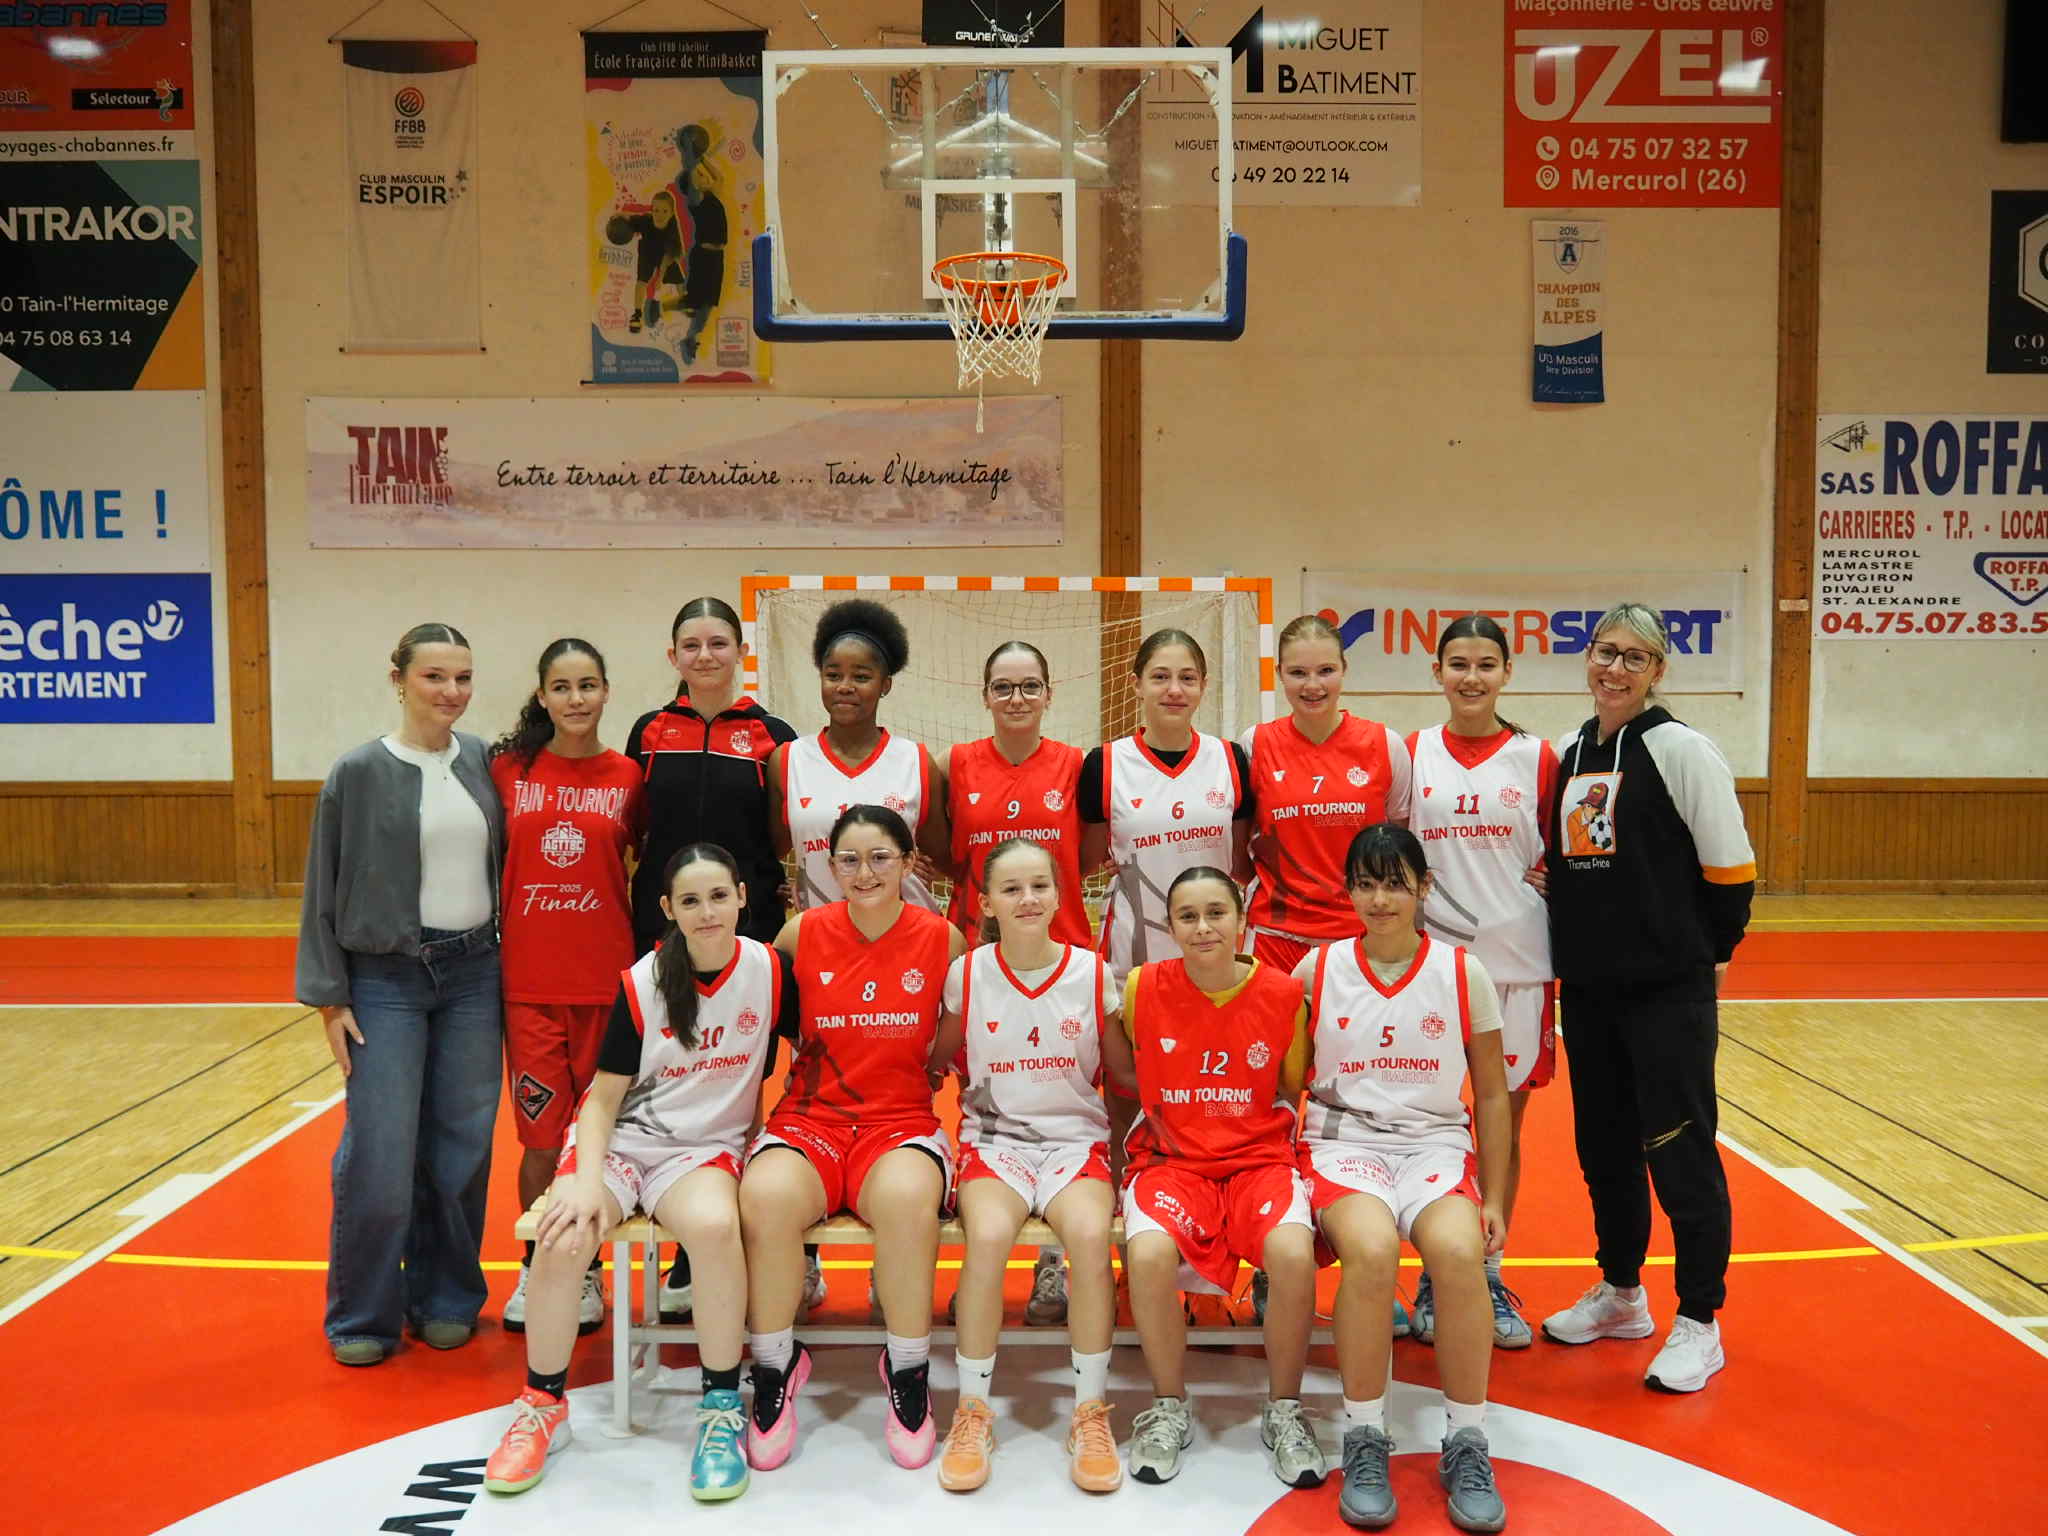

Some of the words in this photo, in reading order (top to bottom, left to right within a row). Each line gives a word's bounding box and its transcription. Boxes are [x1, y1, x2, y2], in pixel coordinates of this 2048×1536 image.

[1514, 0, 1634, 16] Maçonnerie
[1277, 22, 1390, 51] MIGUET
[593, 53, 622, 70] École
[625, 53, 675, 72] Française
[680, 54, 694, 69] de
[697, 52, 757, 69] MiniBasket
[1277, 63, 1417, 95] BATIMENT
[1514, 29, 1772, 124] UZEL
[89, 92, 151, 105] Selectour
[394, 119, 426, 134] FFBB
[1174, 139, 1389, 154] MIGUETATIMENT@OUTLOOK.COM
[1569, 138, 1600, 160] 04
[1607, 138, 1637, 160] 75
[1644, 138, 1674, 160] 07
[1681, 138, 1711, 160] 32
[1719, 138, 1749, 160] 57
[359, 174, 387, 185] CLUB
[390, 174, 446, 185] MASCULIN
[1243, 167, 1266, 183] 49
[1272, 167, 1297, 183] 20
[1302, 167, 1327, 183] 22
[1331, 167, 1350, 183] 14
[1571, 168, 1687, 190] Mercurol
[1697, 168, 1746, 194] (26)
[359, 184, 449, 205] ESPOIR
[1559, 226, 1579, 236] 2016
[1537, 282, 1601, 295] CHAMPION
[17, 295, 169, 315] Tain-l'Hermitage
[1556, 297, 1580, 308] DES
[1542, 310, 1597, 324] ALPES
[20, 330, 45, 346] 75
[50, 330, 74, 346] 08
[79, 330, 103, 346] 63
[108, 330, 131, 346] 14
[347, 426, 449, 485] TAIN
[1820, 472, 1875, 495] SAS
[1883, 420, 2048, 496] ROFFA
[497, 459, 558, 487] Entre
[565, 461, 642, 487] terroir
[648, 464, 676, 486] et
[679, 460, 781, 486] territoire
[824, 460, 876, 486] Tain
[881, 452, 1013, 501] l'Hermitage
[0, 477, 124, 540] ÔME
[1819, 510, 1916, 540] CARRIERES
[1943, 510, 1973, 540] T.P.
[1822, 549, 1921, 559] MERCUROL
[1822, 561, 1913, 570] LAMASTRE
[1822, 573, 1913, 582] PUYGIRON
[2010, 578, 2040, 592] T.P.
[1822, 585, 1895, 594] DIVAJEU
[1822, 597, 1848, 605] ST.
[1855, 597, 1962, 606] ALEXANDRE
[1820, 612, 2048, 634] 04.75.07.83.5
[0, 671, 147, 698] RTEMENT
[1311, 775, 1325, 794] 7
[513, 780, 546, 818] TAIN
[556, 785, 630, 825] TOURNON
[1007, 800, 1021, 819] 9
[1171, 800, 1185, 820] 6
[1271, 805, 1299, 821] TAIN
[1302, 802, 1366, 816] TOURNON
[1454, 793, 1480, 815] 11
[996, 828, 1060, 843] TOURNON
[1132, 833, 1161, 849] TAIN
[1164, 825, 1224, 844] TOURNON
[1421, 827, 1448, 841] TAIN
[1451, 825, 1513, 838] TOURNON
[803, 837, 831, 853] AIN
[522, 883, 602, 916] Finale
[862, 980, 877, 1002] 8
[815, 1015, 846, 1029] TAIN
[849, 1012, 919, 1027] TOURNON
[698, 1025, 725, 1051] 10
[1027, 1026, 1040, 1048] 4
[1379, 1025, 1395, 1048] 5
[987, 1061, 1015, 1073] TAIN
[1200, 1049, 1230, 1076] 12
[1338, 1061, 1366, 1074] TAIN
[1369, 1057, 1440, 1071] TOURNON
[1160, 1087, 1191, 1104] TAIN
